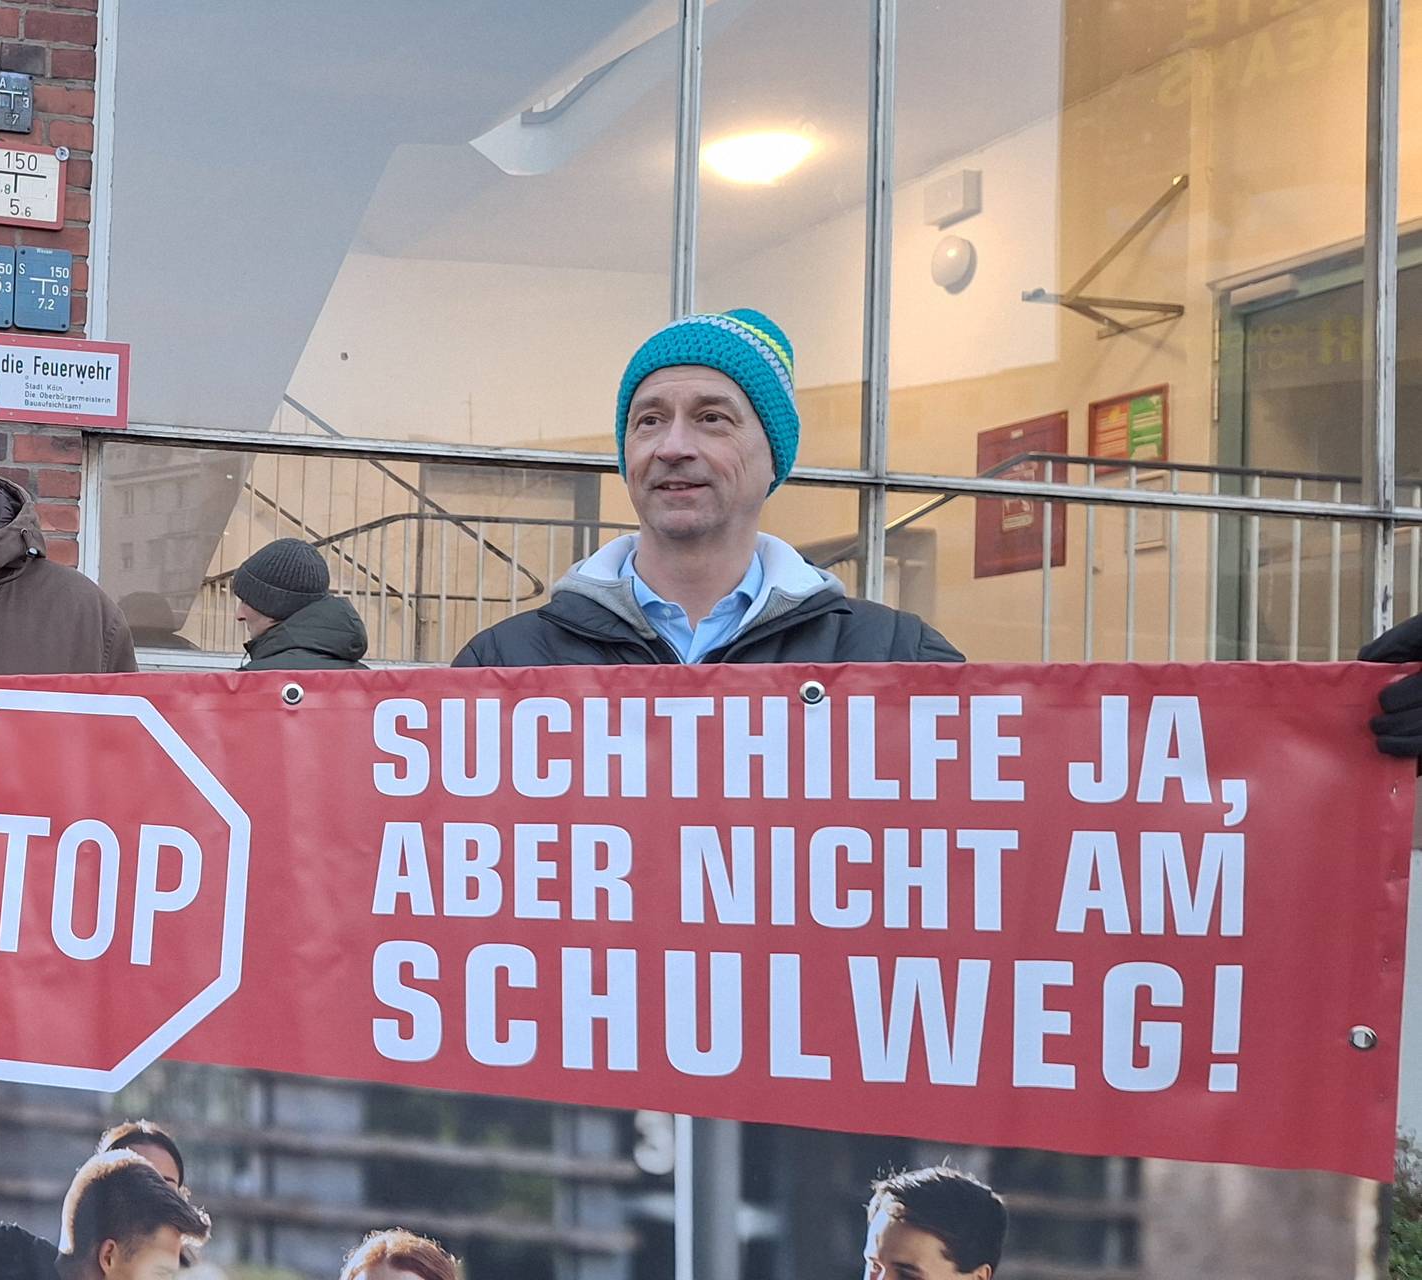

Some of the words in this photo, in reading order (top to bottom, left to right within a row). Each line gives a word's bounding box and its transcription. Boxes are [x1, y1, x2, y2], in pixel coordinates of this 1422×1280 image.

[0, 77, 7, 88] A
[3, 151, 38, 171] 150
[19, 263, 26, 275] S
[50, 266, 69, 278] 150
[1, 353, 24, 374] die
[33, 355, 112, 381] Feuerwehr
[24, 382, 43, 391] Stadt
[46, 383, 63, 391] Köln
[24, 398, 82, 410] Bauaufsichtsamt
[39, 391, 111, 404] Oberbürgermeisterin
[372, 695, 1026, 802] SUCHTHILFE
[1068, 695, 1249, 827] JA,
[371, 821, 634, 923] ABER
[680, 825, 1020, 933] NICHT
[1056, 830, 1246, 937] AM
[372, 939, 1244, 1093] SCHULWEG!
